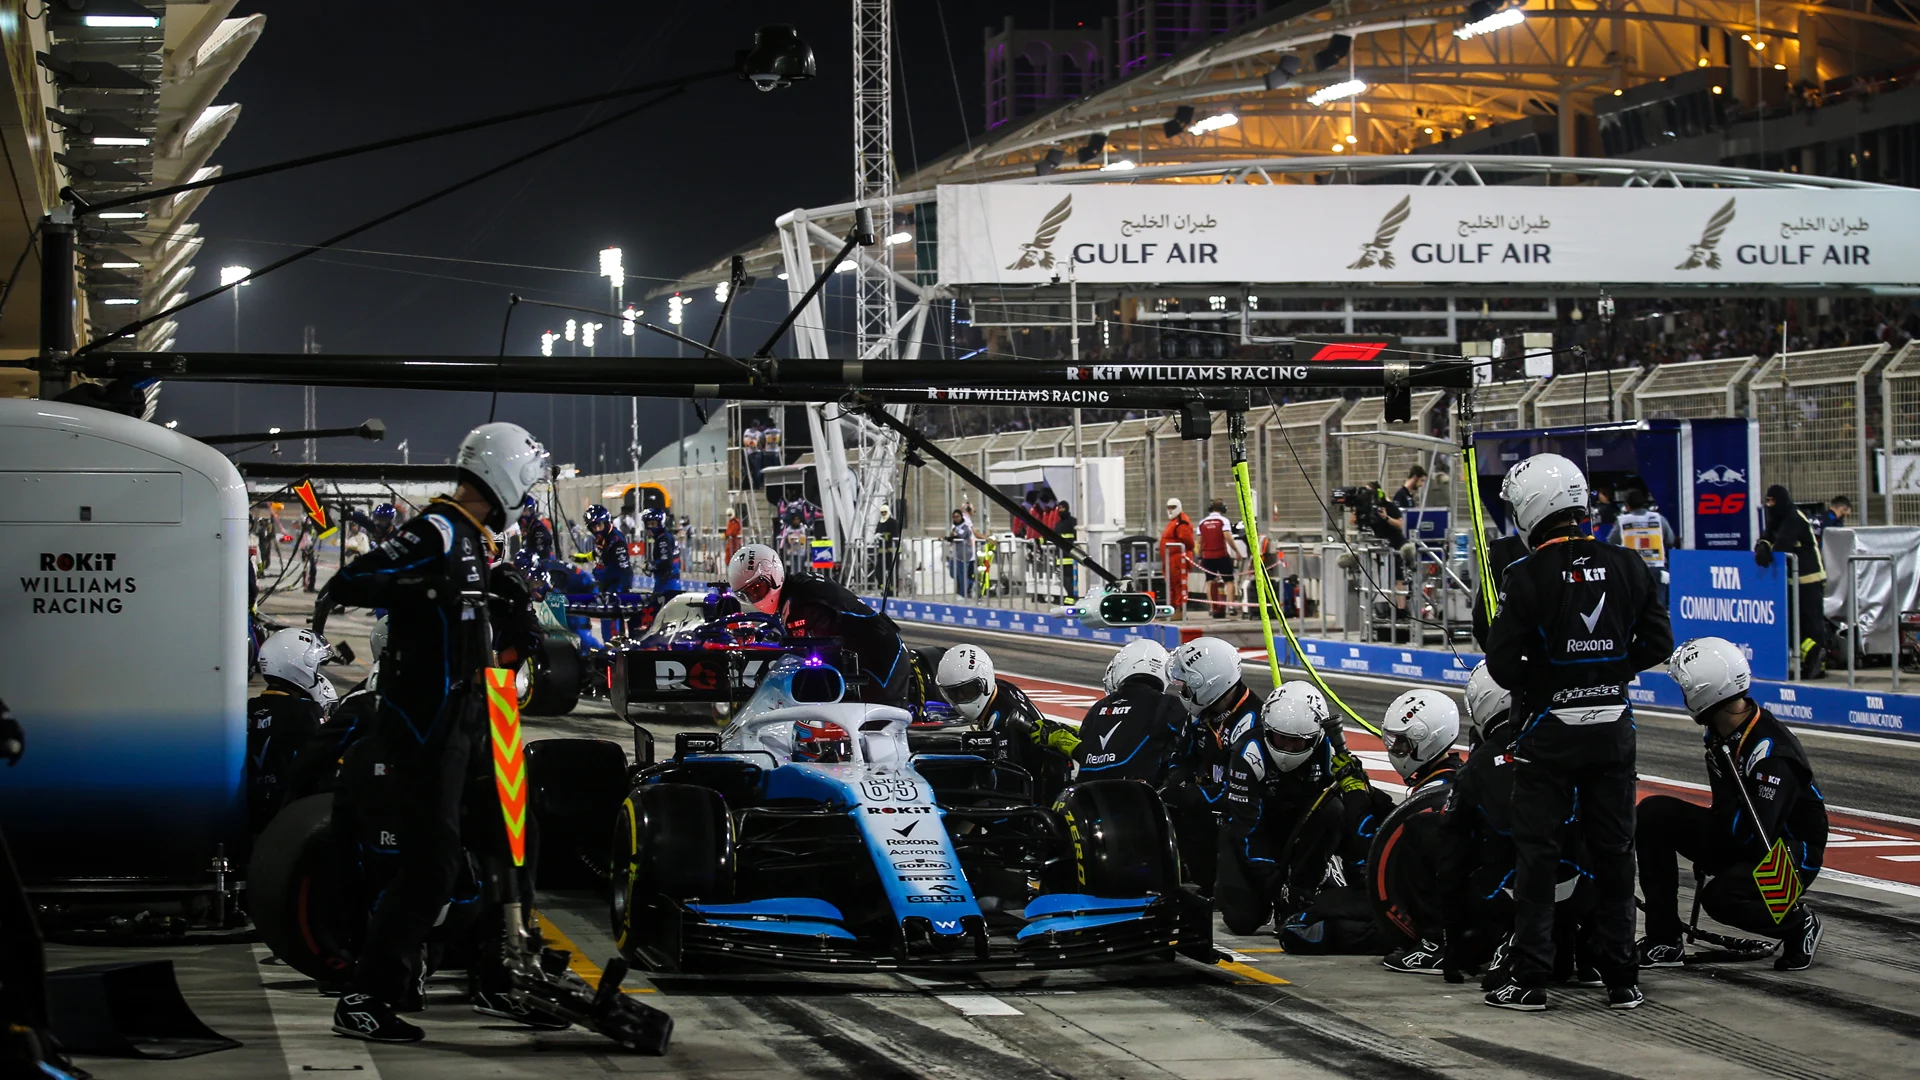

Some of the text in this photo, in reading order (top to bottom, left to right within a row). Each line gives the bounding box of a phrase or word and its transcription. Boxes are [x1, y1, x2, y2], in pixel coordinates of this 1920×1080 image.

[1121, 214, 1217, 237] طيران الخليج
[1458, 215, 1550, 237] طيران الخليج
[1780, 217, 1870, 239] طيران الخليج
[1073, 243, 1218, 263] GULF AIR
[1411, 243, 1552, 263] GULF AIR
[1737, 244, 1870, 265] GULF AIR
[1129, 367, 1226, 380] WILLIAMS
[1231, 367, 1308, 380] RACING
[975, 388, 1049, 402] WILLIAMS
[1052, 390, 1109, 402] RACING
[1697, 493, 1746, 515] 26
[20, 577, 136, 593] WILLIAMS
[1710, 566, 1741, 590] TATA
[33, 598, 123, 614] RACING
[1680, 596, 1775, 625] COMMUNICATIONS
[1567, 638, 1614, 652] Rexona
[1552, 684, 1620, 704] alpinestars
[1779, 688, 1796, 702] TATA
[1865, 696, 1884, 710] TATA
[1763, 702, 1813, 719] COMMUNICATIONS
[1849, 710, 1903, 729] COMMUNICATIONS
[1085, 752, 1116, 764] Rexona
[860, 778, 919, 802] 63
[886, 838, 939, 846] Rexona
